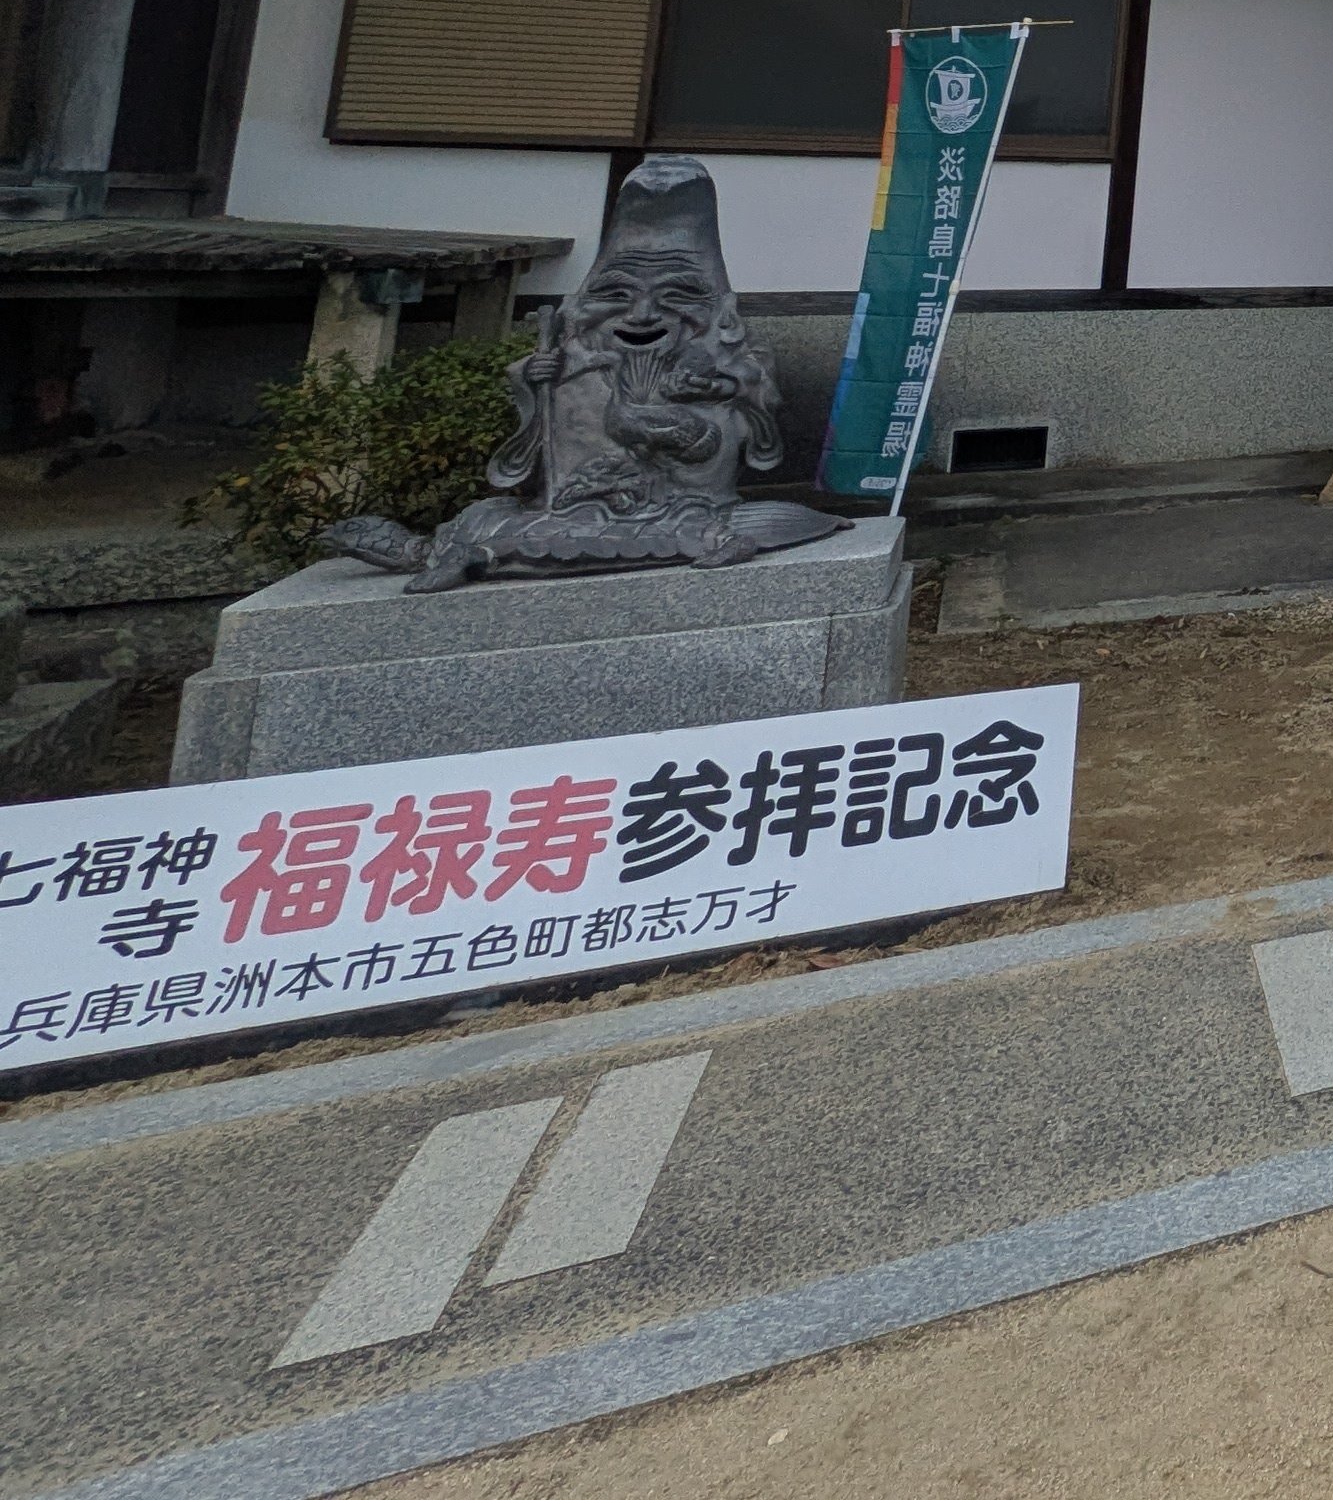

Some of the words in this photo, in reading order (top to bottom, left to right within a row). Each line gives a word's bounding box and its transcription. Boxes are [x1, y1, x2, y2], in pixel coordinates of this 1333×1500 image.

[0, 827, 217, 908] 七福神
[99, 898, 199, 959] 寺
